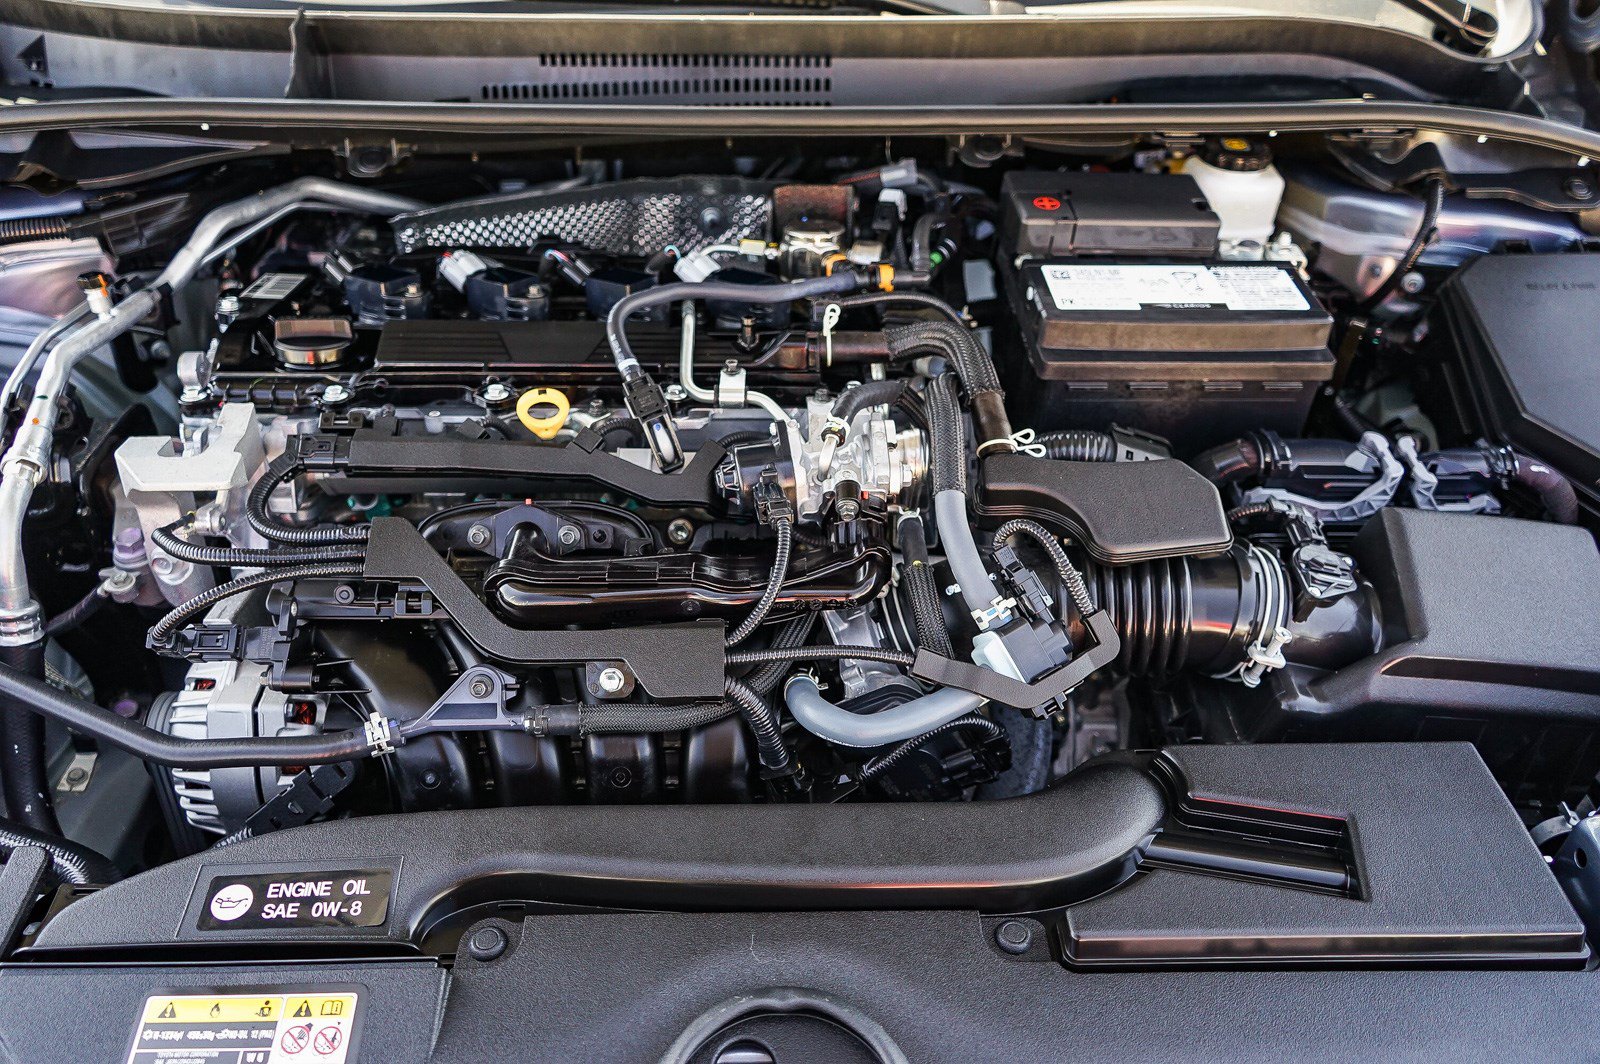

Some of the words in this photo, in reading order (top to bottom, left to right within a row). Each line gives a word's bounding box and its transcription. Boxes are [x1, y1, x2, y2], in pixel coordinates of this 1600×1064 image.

[266, 881, 332, 899] ENGINE
[342, 880, 371, 896] OIL
[261, 903, 300, 919] SAE
[311, 901, 362, 918] 0W-8
